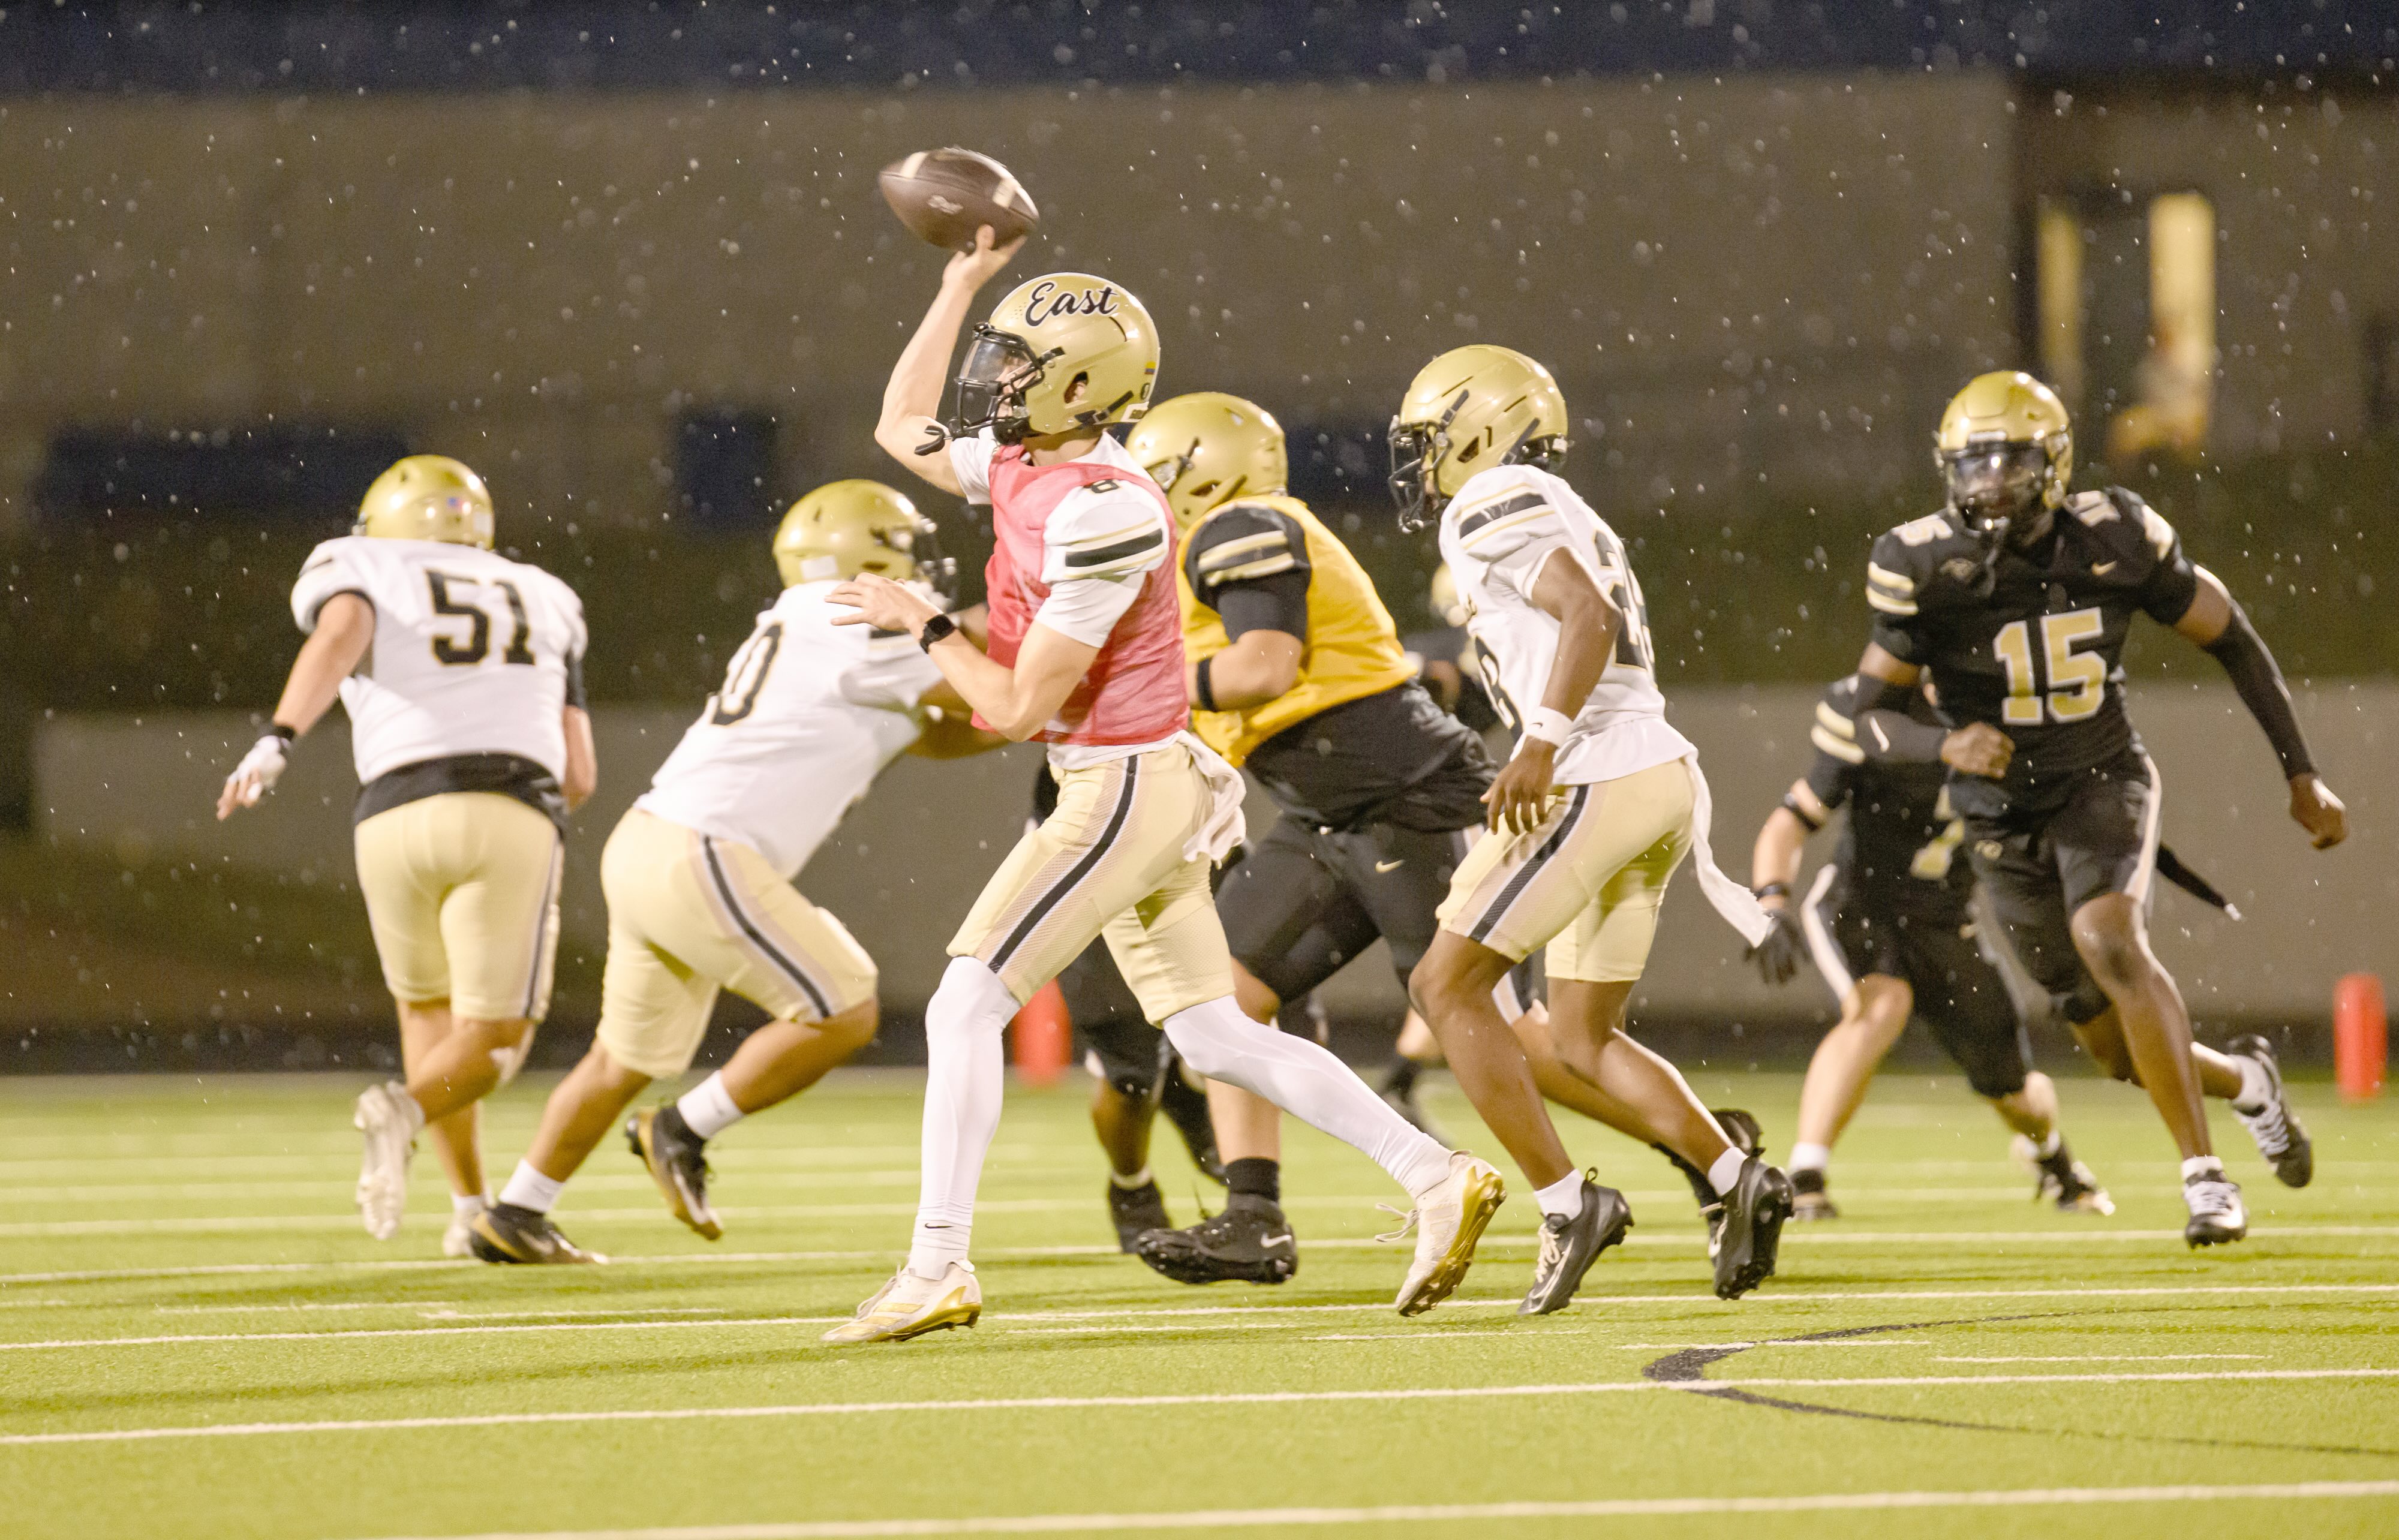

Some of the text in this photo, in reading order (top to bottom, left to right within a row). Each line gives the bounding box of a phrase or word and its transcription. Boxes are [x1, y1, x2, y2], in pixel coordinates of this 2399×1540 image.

[1025, 281, 1119, 327] East
[425, 567, 536, 666] 51
[1992, 607, 2106, 726] 15
